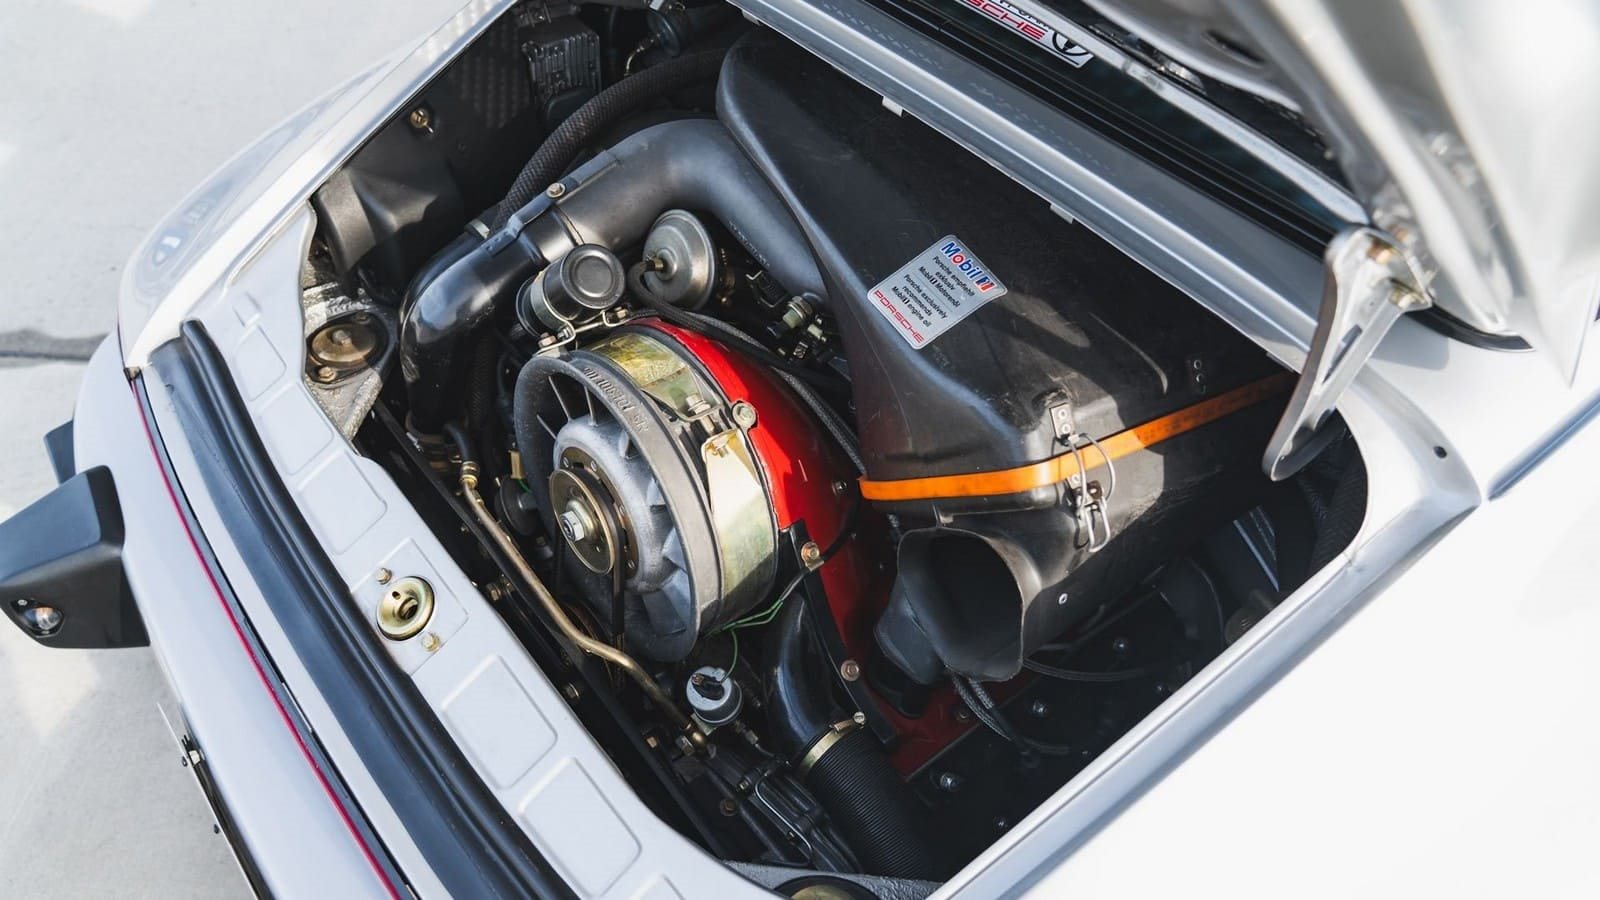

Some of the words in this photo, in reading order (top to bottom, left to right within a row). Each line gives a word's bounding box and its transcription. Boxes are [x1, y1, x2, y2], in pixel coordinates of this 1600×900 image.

[932, 256, 953, 275] Porsche
[941, 241, 982, 279] Mobil
[935, 271, 955, 290] exklusiv
[902, 286, 932, 316] recommends
[903, 274, 923, 293] Porsche
[920, 292, 947, 319] exclusively
[874, 289, 924, 343] PORSCHE
[907, 303, 924, 320] engine
[922, 318, 932, 327] oil
